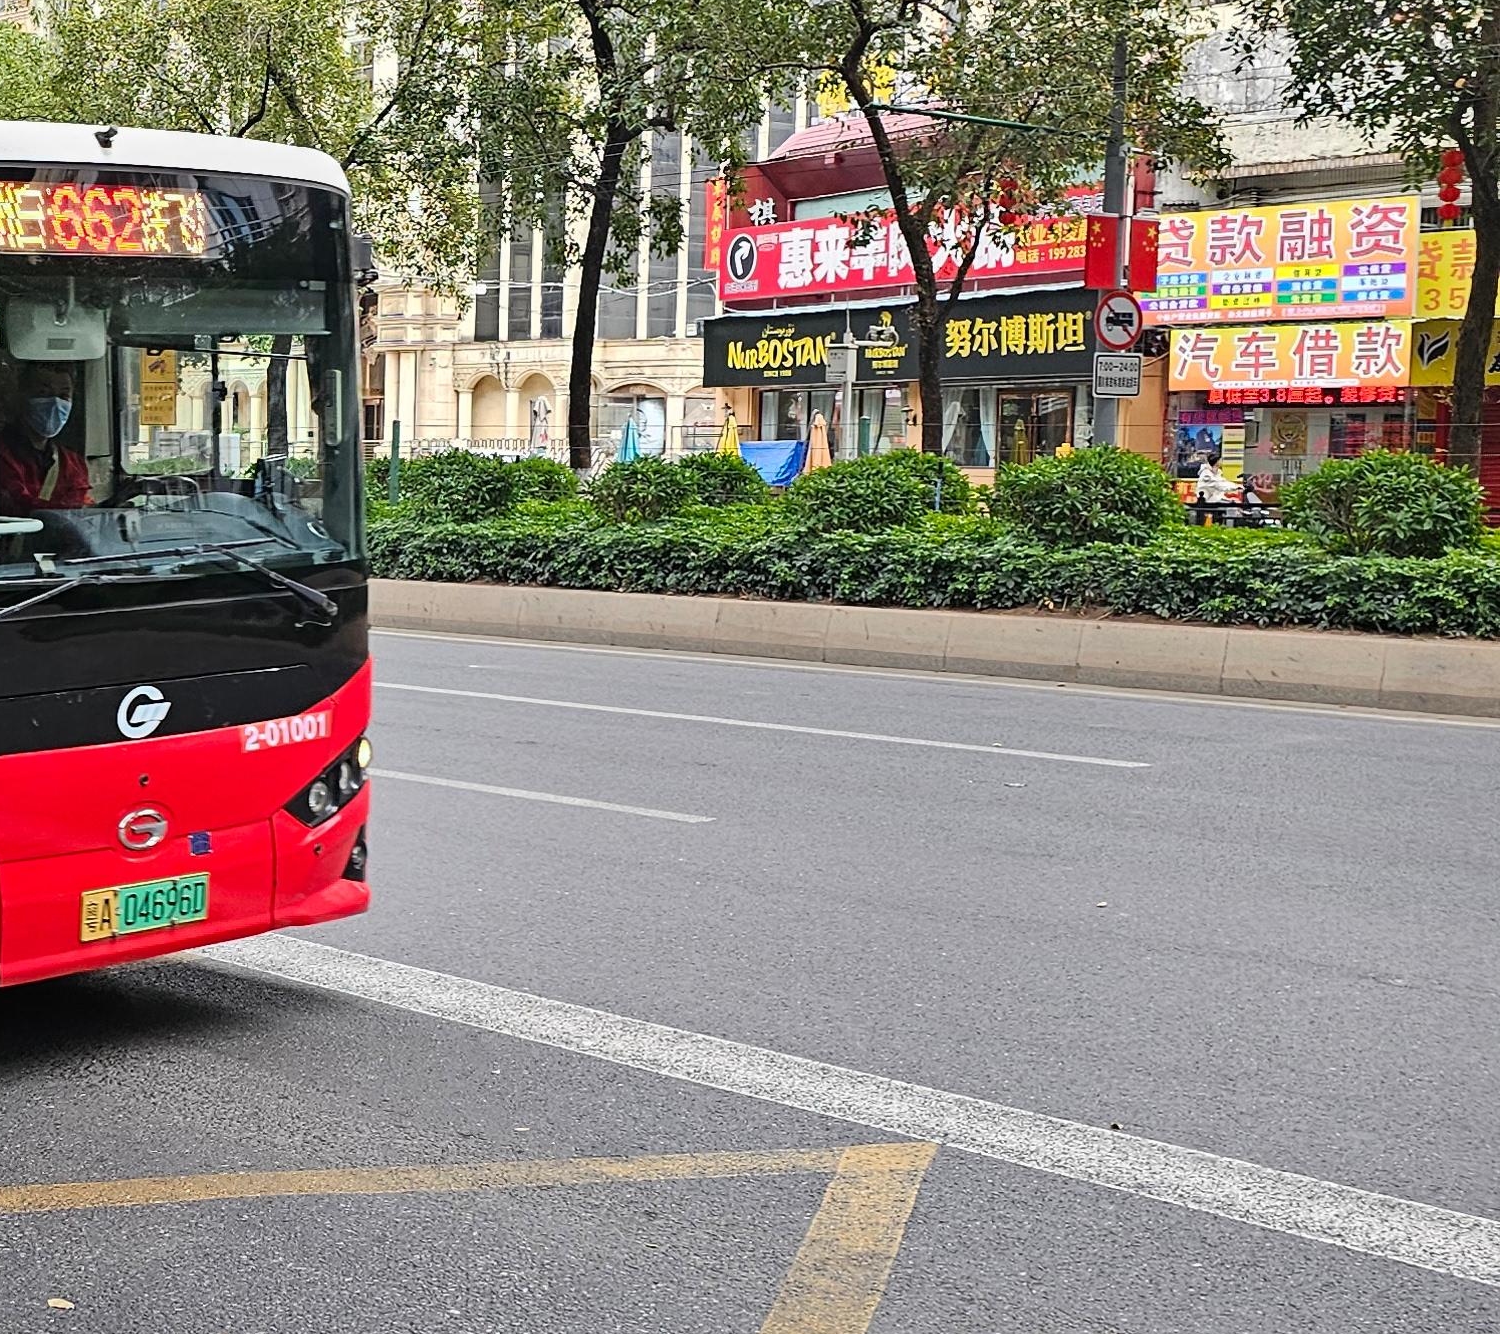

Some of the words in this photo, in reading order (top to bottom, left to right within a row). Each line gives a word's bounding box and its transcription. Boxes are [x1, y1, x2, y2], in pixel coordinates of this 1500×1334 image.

[748, 197, 778, 226] 棋
[945, 311, 1086, 358] 努尔博斯坦
[1177, 326, 1402, 378] 汽车借款
[243, 713, 327, 752] 2-01001
